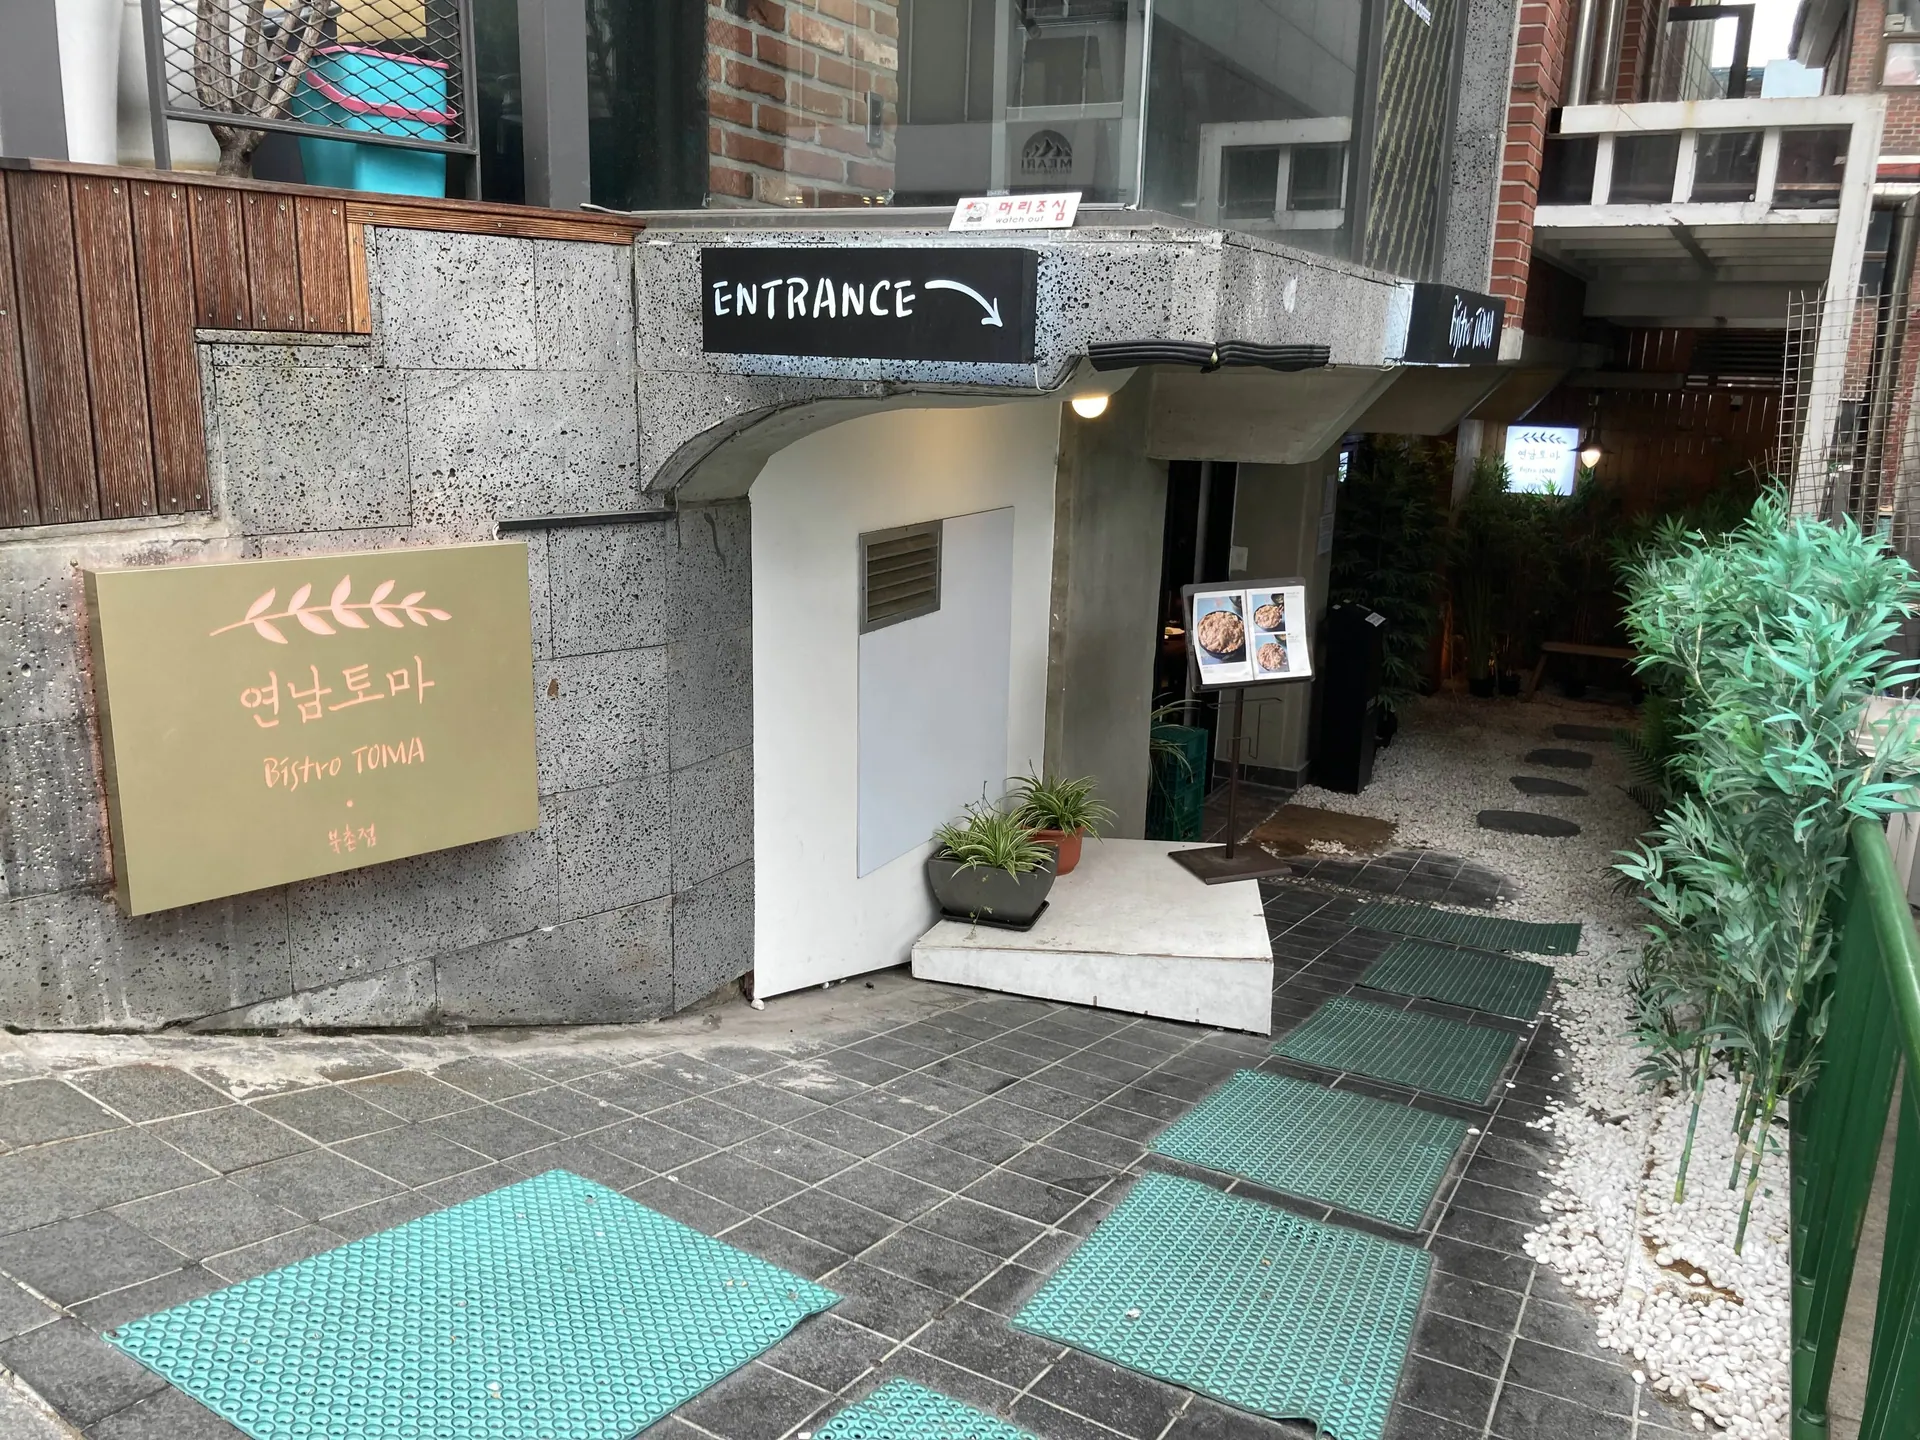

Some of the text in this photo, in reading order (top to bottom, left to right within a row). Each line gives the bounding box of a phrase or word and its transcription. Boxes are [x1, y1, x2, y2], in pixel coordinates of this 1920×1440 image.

[995, 215, 1044, 224] watch out
[999, 199, 1067, 221] 머리조심
[712, 277, 916, 320] ENTRANCE
[1517, 448, 1561, 460] 연남토마
[240, 655, 435, 728] 연남토마
[263, 737, 425, 792] Bistro TOMA
[328, 823, 377, 854] 북촌점
